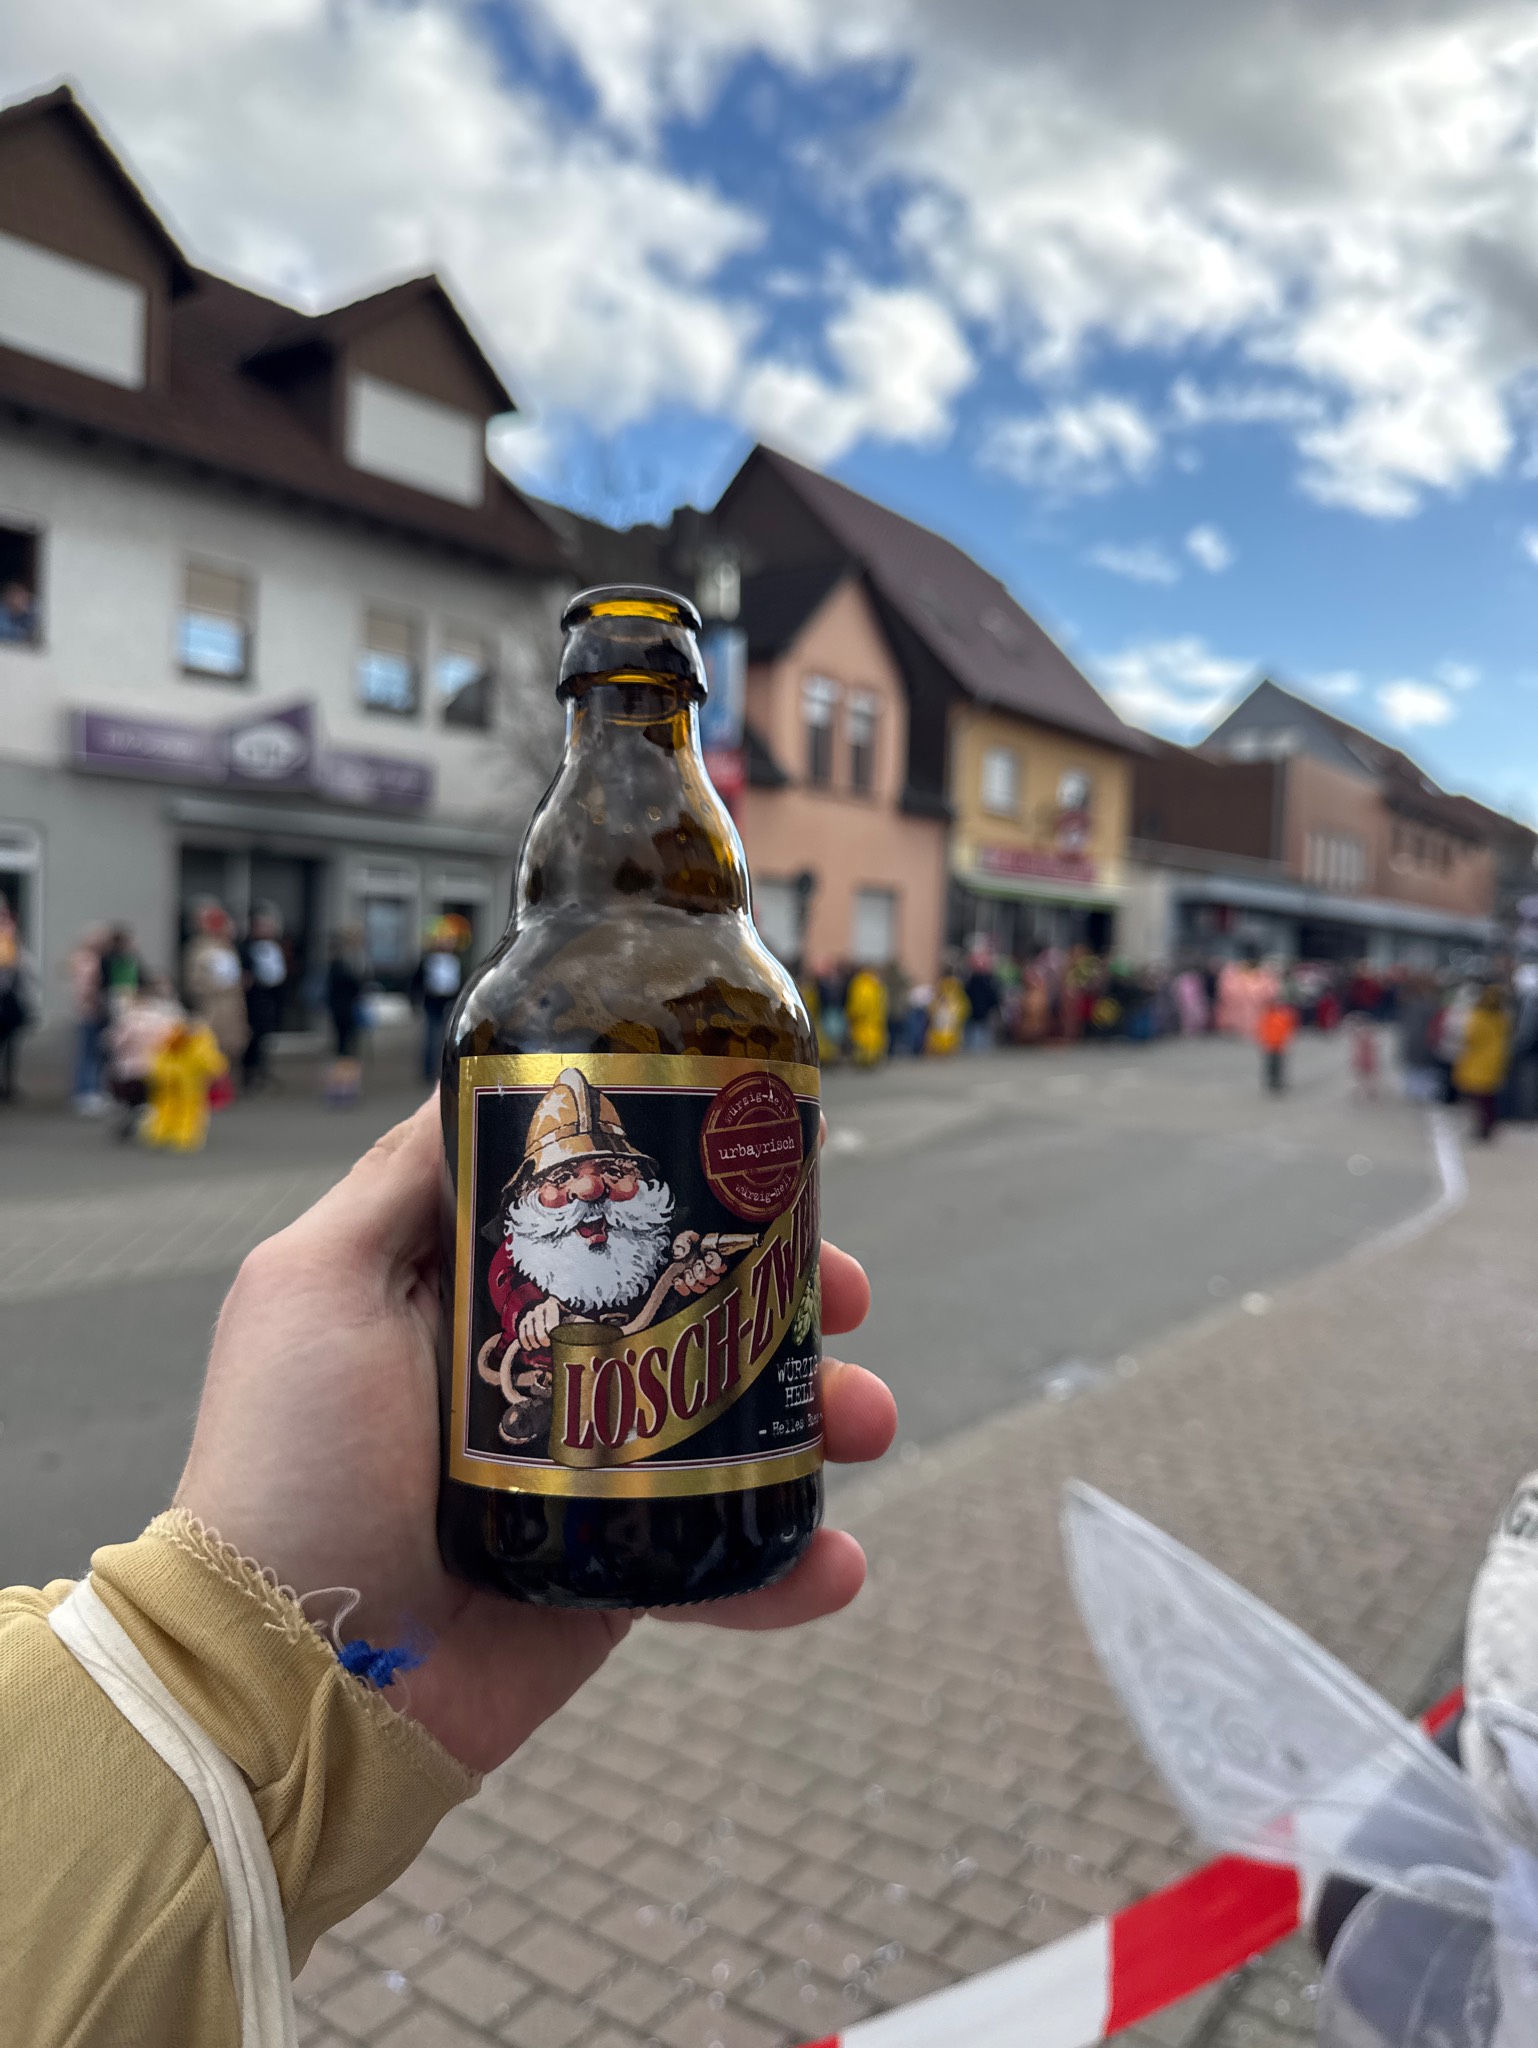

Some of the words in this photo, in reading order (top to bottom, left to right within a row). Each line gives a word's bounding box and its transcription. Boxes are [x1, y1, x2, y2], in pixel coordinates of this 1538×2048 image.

[718, 1136, 796, 1160] urbayrisch
[785, 1381, 815, 1408] HELL
[772, 1419, 805, 1437] Helles
